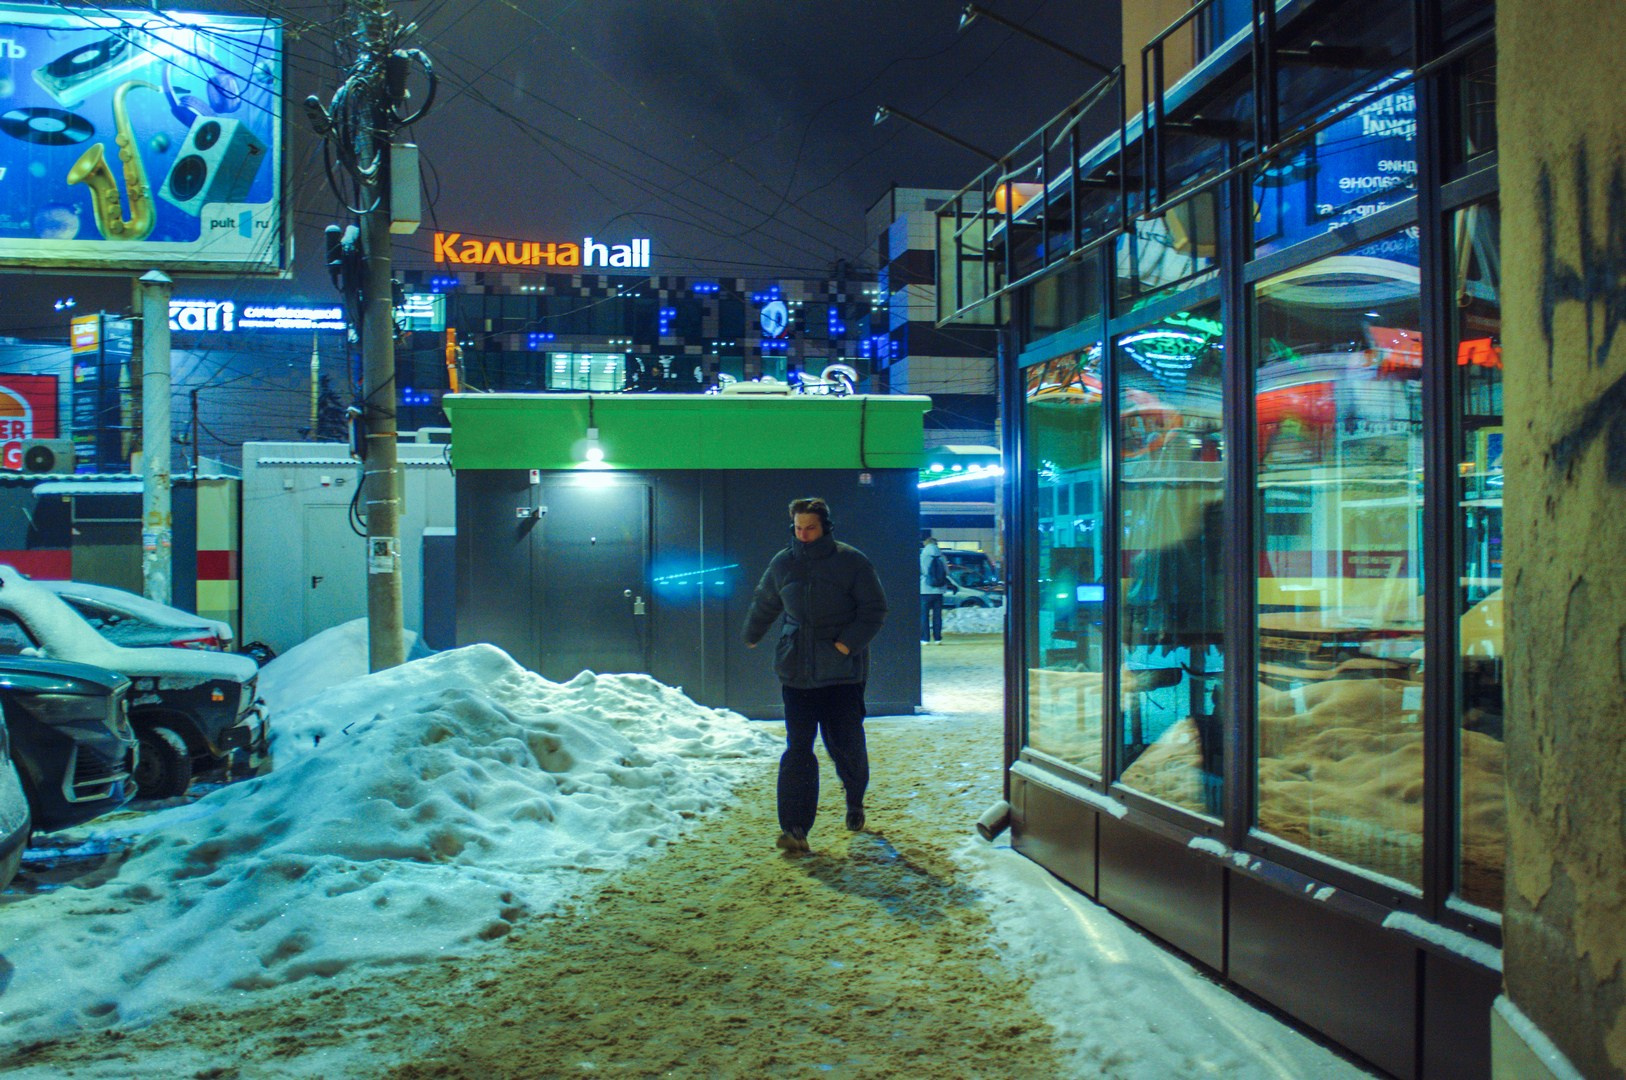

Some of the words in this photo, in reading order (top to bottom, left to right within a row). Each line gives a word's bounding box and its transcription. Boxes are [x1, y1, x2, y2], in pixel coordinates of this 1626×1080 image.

[210, 217, 235, 230] pult
[433, 232, 580, 266] Калина
[583, 237, 650, 267] hall
